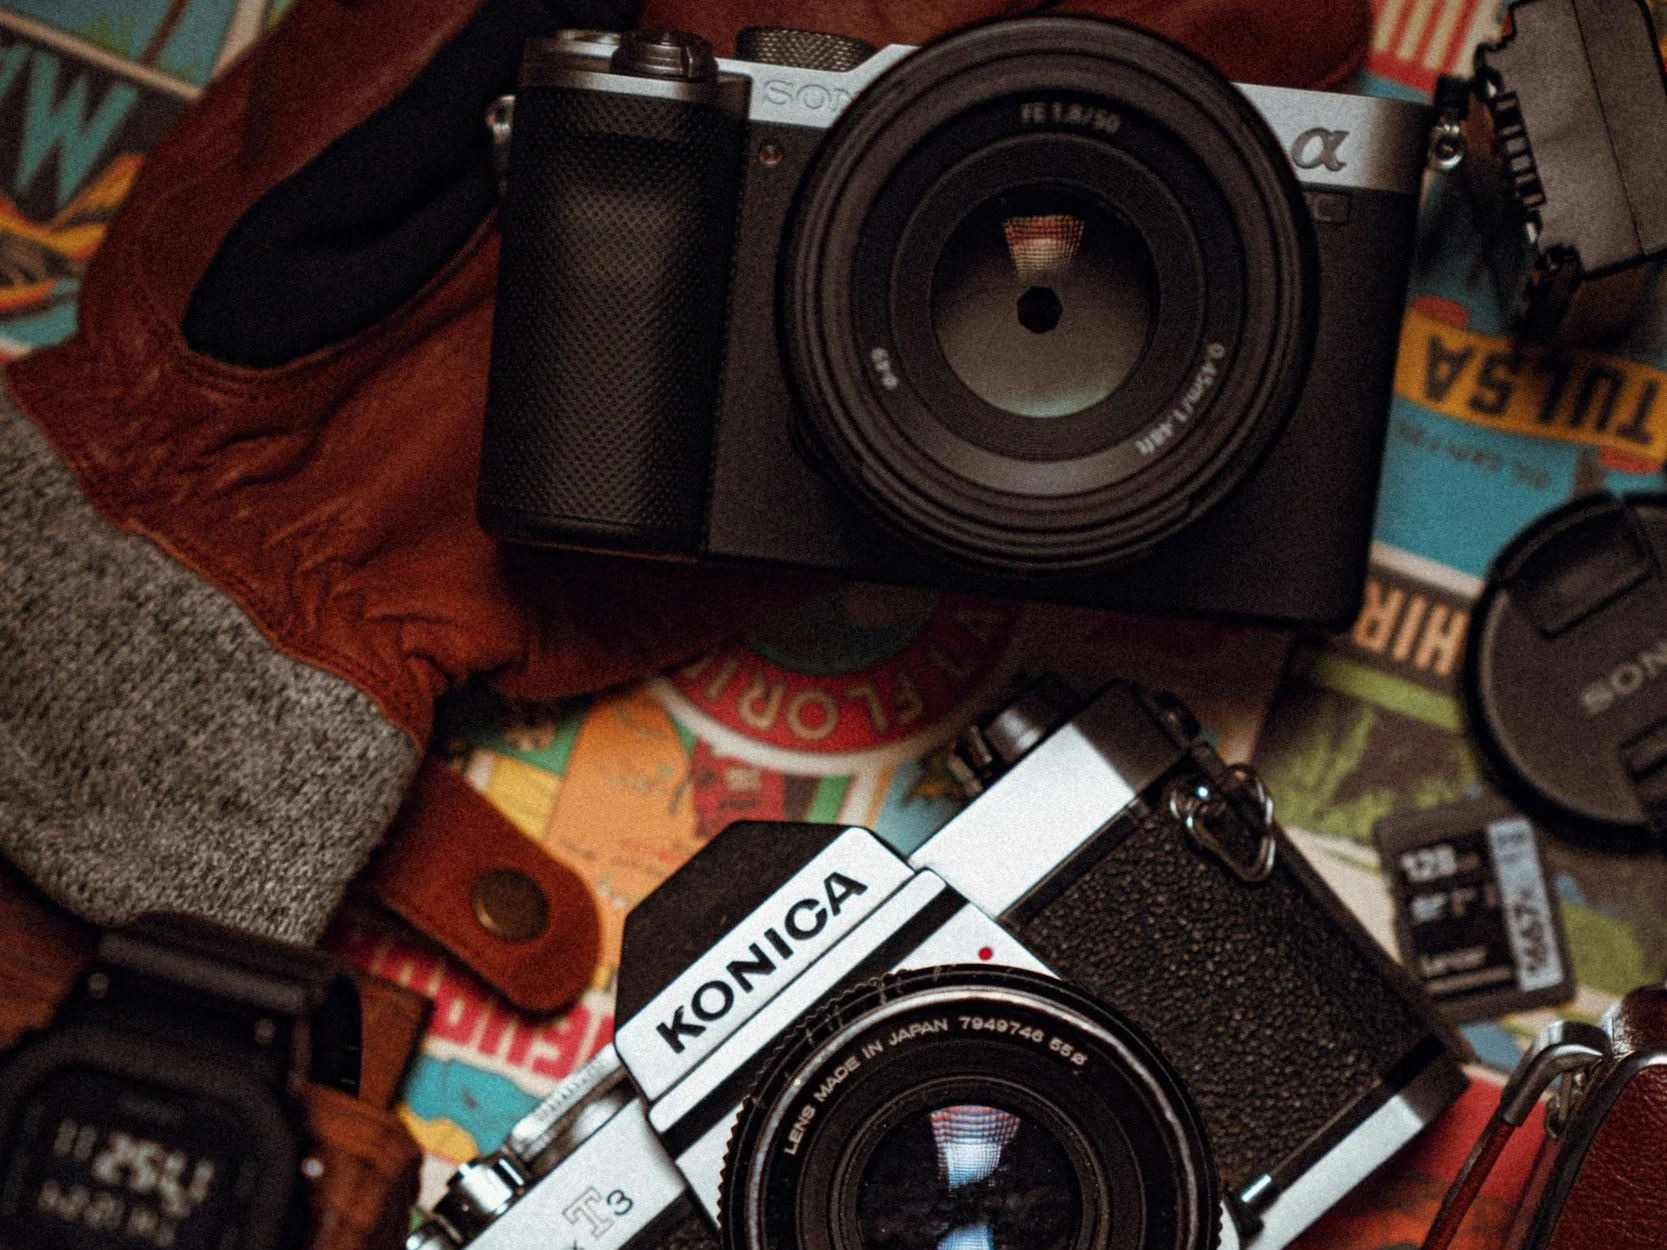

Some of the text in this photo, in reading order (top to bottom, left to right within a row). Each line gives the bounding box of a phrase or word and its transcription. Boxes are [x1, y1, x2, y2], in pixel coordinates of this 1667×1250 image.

[1425, 333, 1659, 444] TULSA
[1581, 642, 1667, 714] SON
[655, 870, 868, 1054] KONICA
[782, 1104, 816, 1157] LENS
[813, 1053, 861, 1103] MADE
[861, 1039, 885, 1060] IN
[888, 1016, 949, 1046] JAPAN
[958, 1015, 1045, 1044] 7949746
